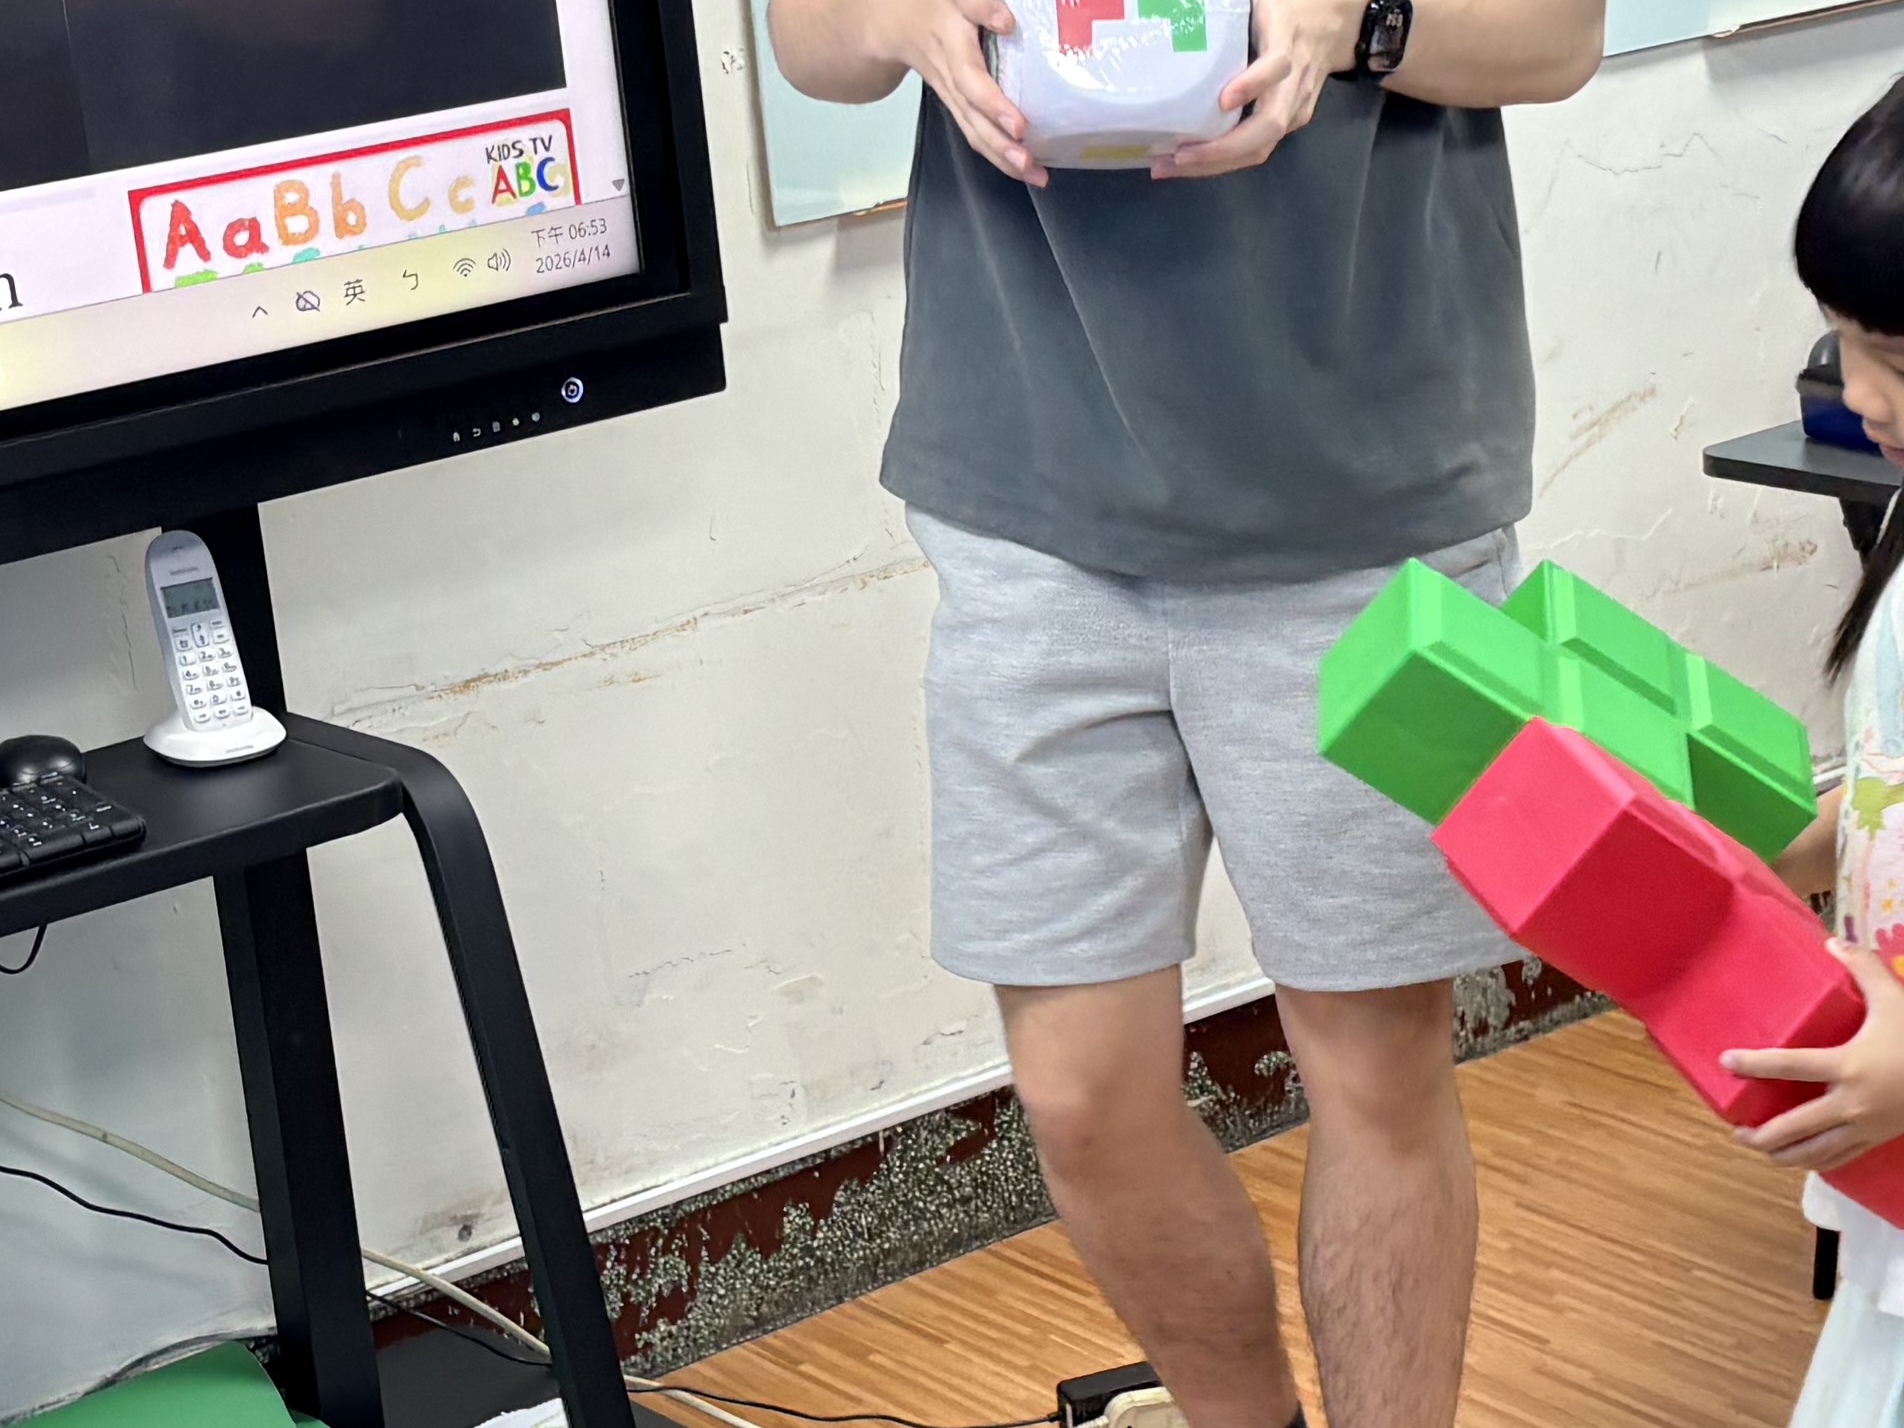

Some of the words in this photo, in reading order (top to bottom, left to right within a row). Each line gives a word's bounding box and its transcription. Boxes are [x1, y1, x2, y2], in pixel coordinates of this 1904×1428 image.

[486, 142, 523, 164] KIDS
[529, 136, 553, 155] TV
[491, 157, 559, 205] ABC
[532, 224, 563, 245] 下午
[569, 219, 608, 241] 06:53
[535, 245, 611, 273] 2026/4/14
[344, 280, 366, 305] 英
